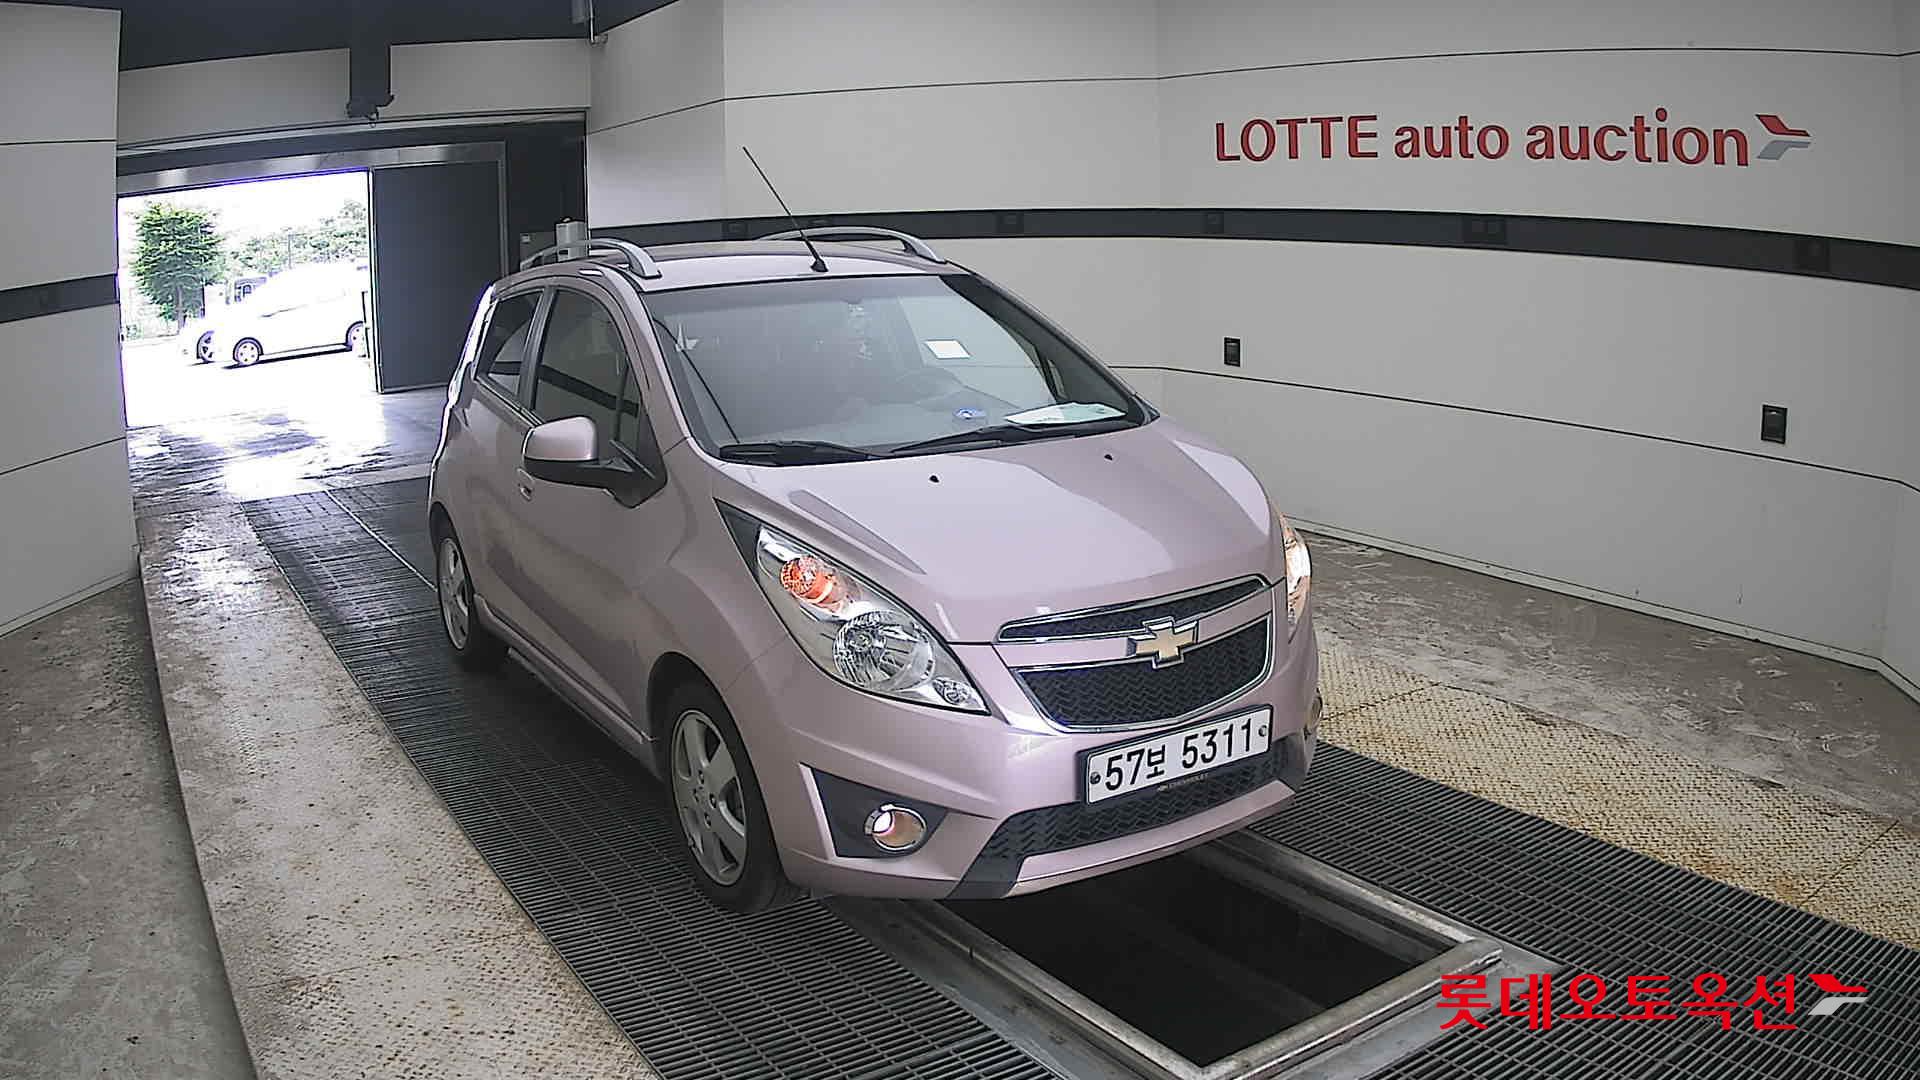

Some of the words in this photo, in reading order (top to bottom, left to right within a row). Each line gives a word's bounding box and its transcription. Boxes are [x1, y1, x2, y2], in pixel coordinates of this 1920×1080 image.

[1215, 115, 1378, 162] LOTTE
[1394, 115, 1510, 159] auto
[1525, 107, 1749, 166] auction
[1105, 744, 1165, 791] 57보
[1181, 718, 1251, 769] 5311
